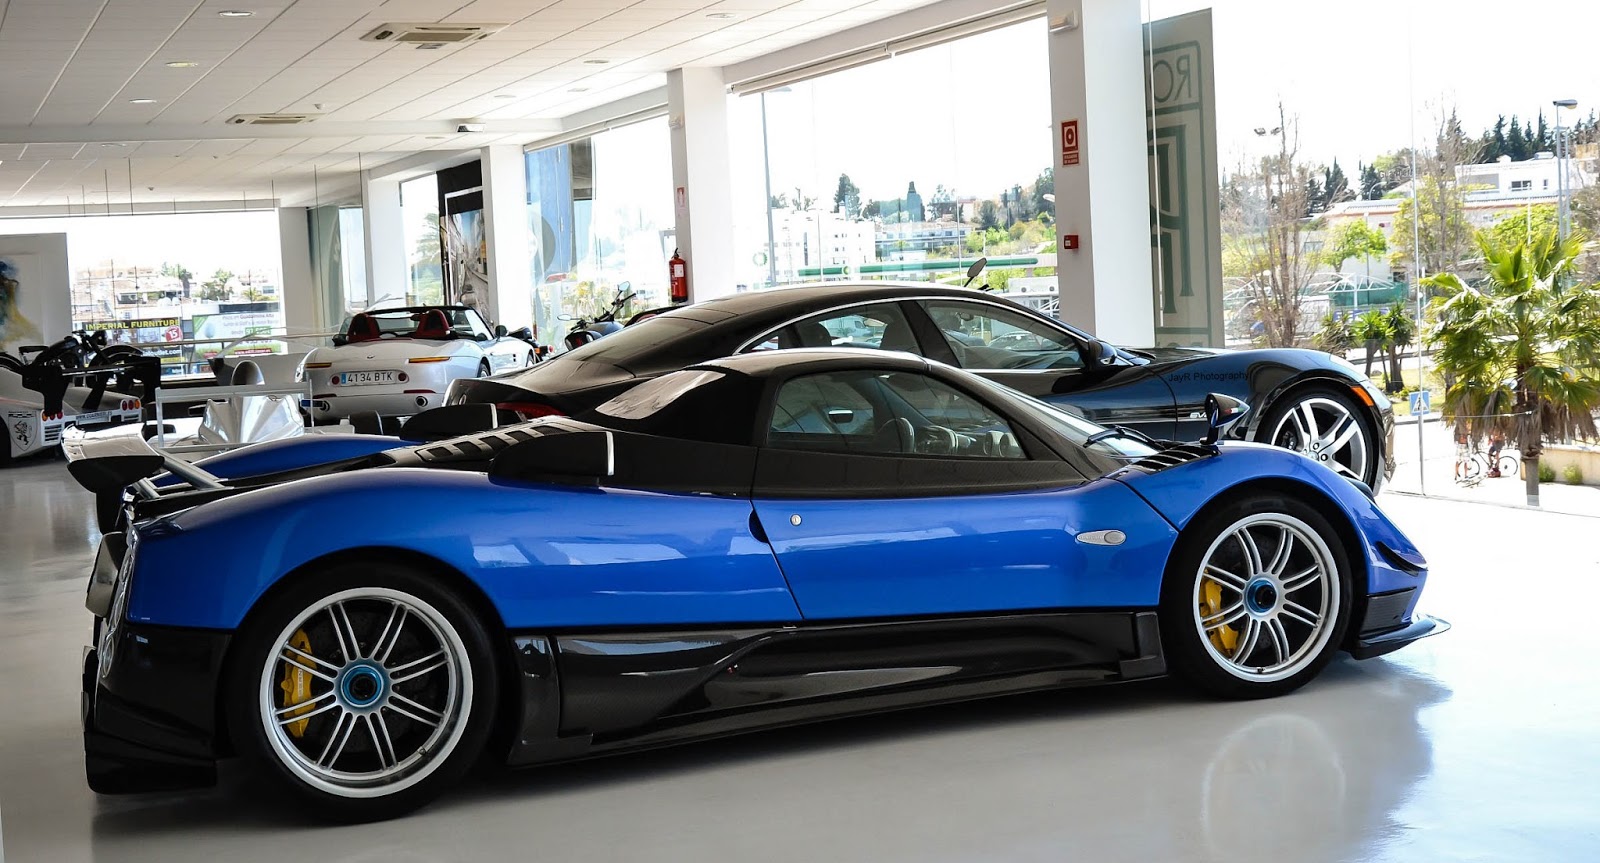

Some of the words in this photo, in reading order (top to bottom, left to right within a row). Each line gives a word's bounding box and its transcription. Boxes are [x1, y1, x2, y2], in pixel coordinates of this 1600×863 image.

[85, 322, 129, 331] IMPERIAL
[131, 319, 180, 329] FURNITURE
[169, 329, 178, 338] 15
[348, 373, 372, 383] 4134
[374, 372, 393, 382] BTK
